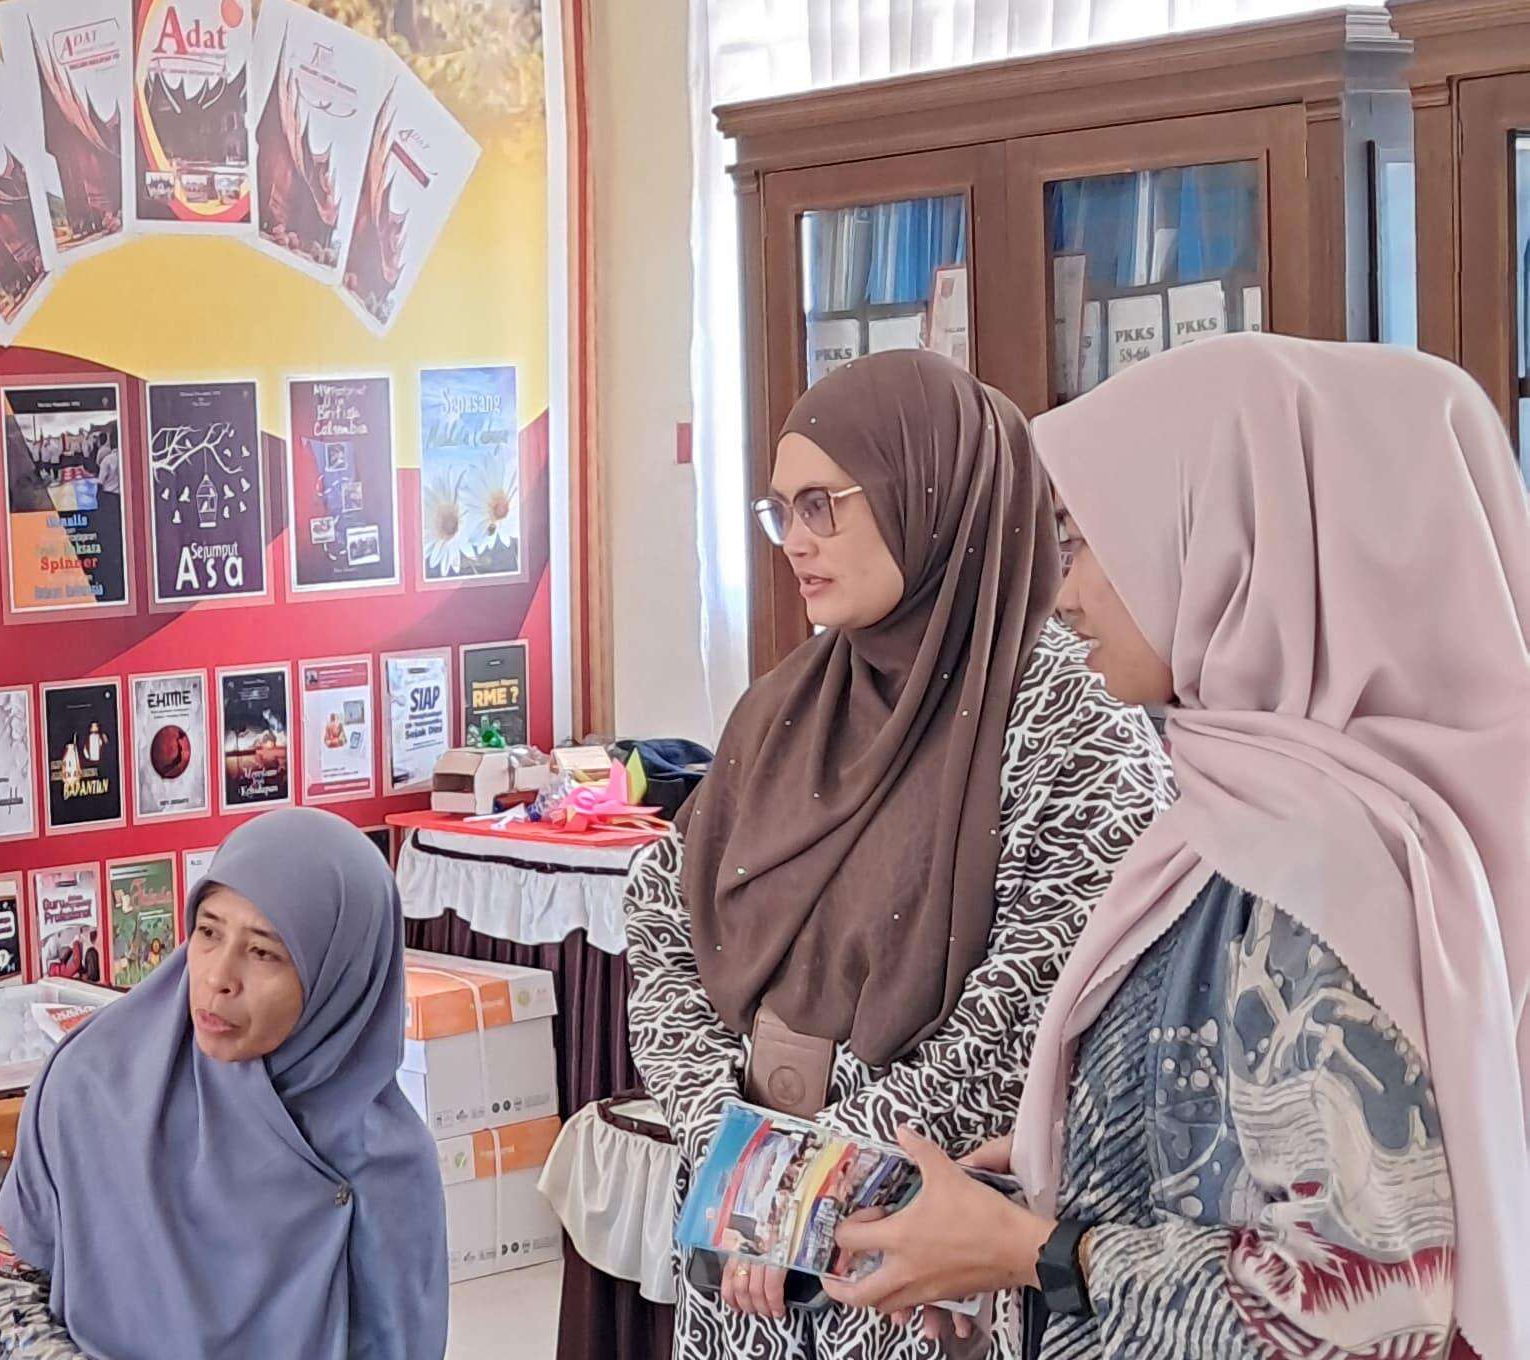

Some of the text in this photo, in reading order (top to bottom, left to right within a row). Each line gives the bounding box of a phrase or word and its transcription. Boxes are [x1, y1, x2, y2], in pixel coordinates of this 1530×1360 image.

[151, 5, 228, 55] Adat
[1115, 326, 1155, 343] PKKS
[1175, 317, 1218, 335] PKKS
[815, 347, 853, 361] PKKS
[191, 541, 239, 563] Sejumput
[175, 546, 244, 591] Asa
[146, 690, 192, 709] EHIME
[410, 685, 440, 713] SIAP
[472, 686, 519, 709] RME ?
